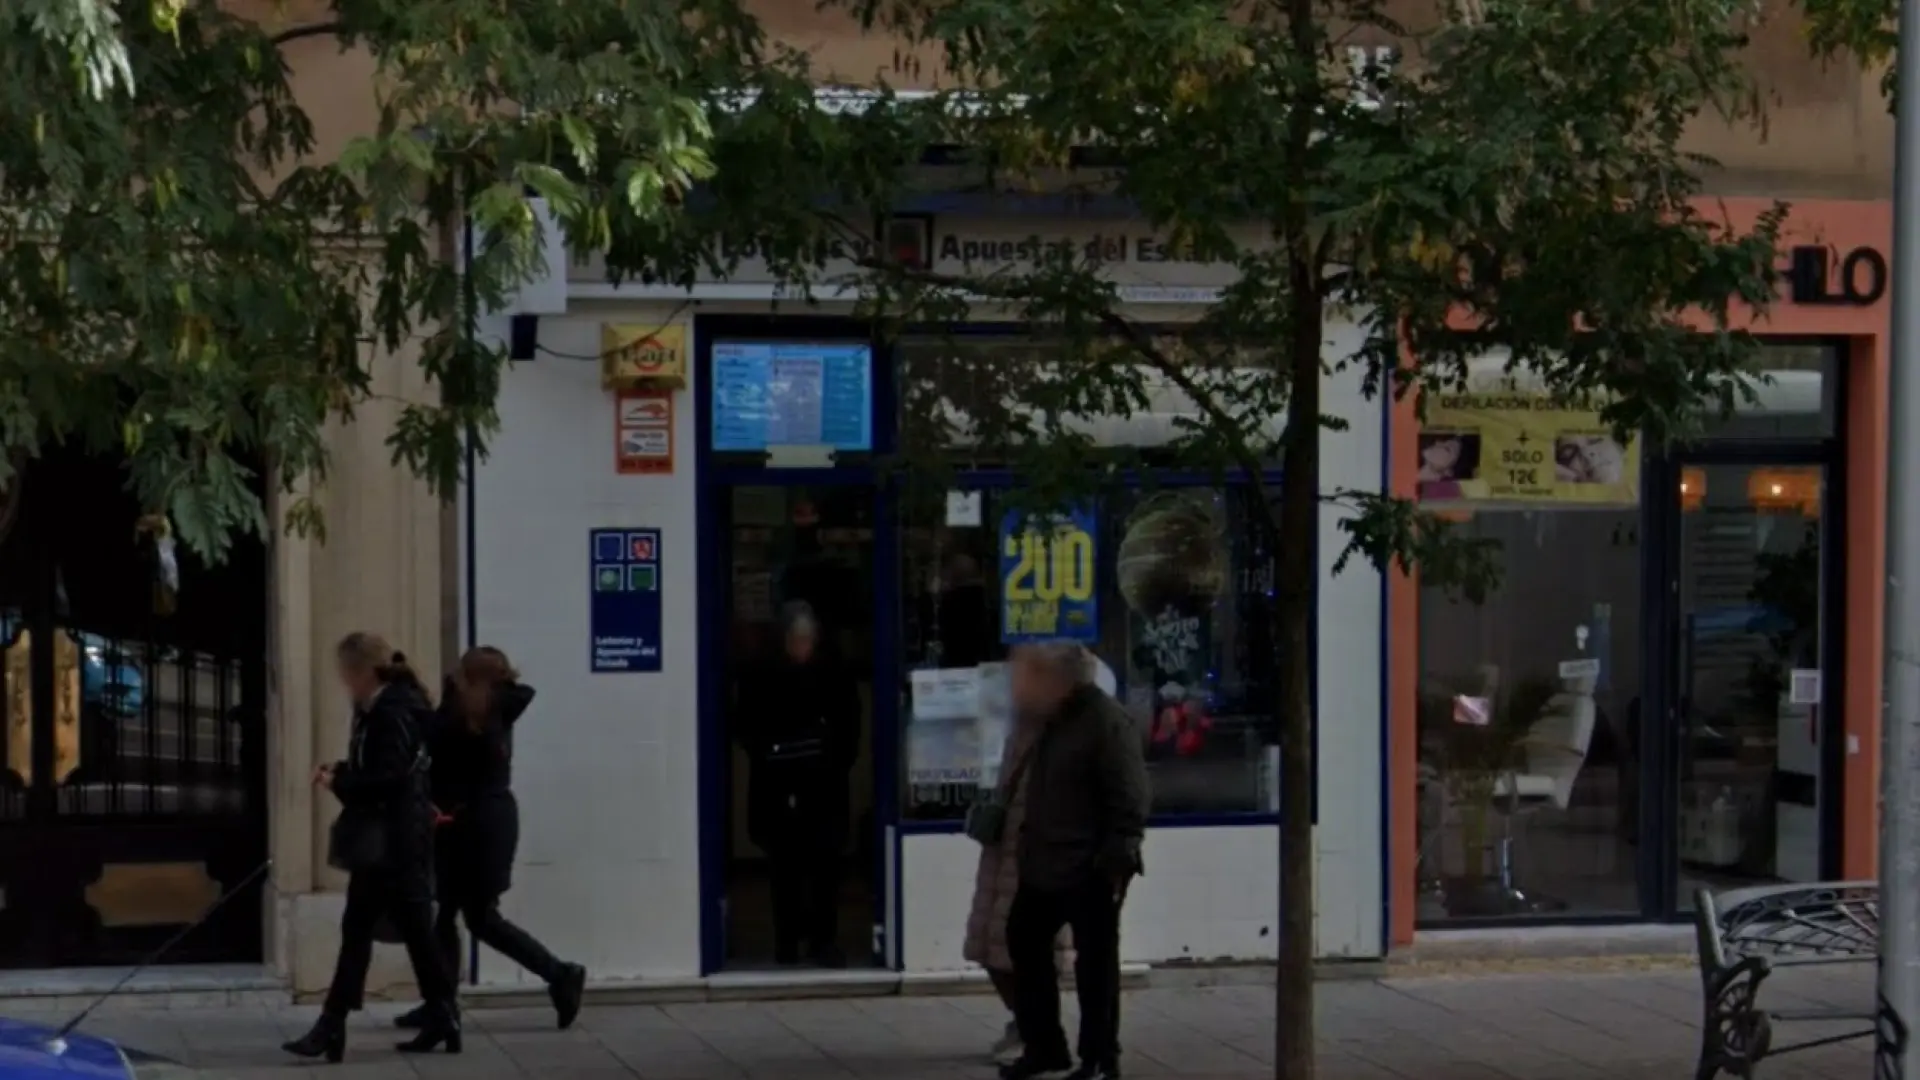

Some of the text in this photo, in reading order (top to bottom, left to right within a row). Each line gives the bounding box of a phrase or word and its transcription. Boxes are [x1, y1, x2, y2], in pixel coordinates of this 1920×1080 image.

[1085, 236, 1126, 261] del
[1503, 450, 1544, 464] SOLO
[1003, 528, 1091, 602] 200
